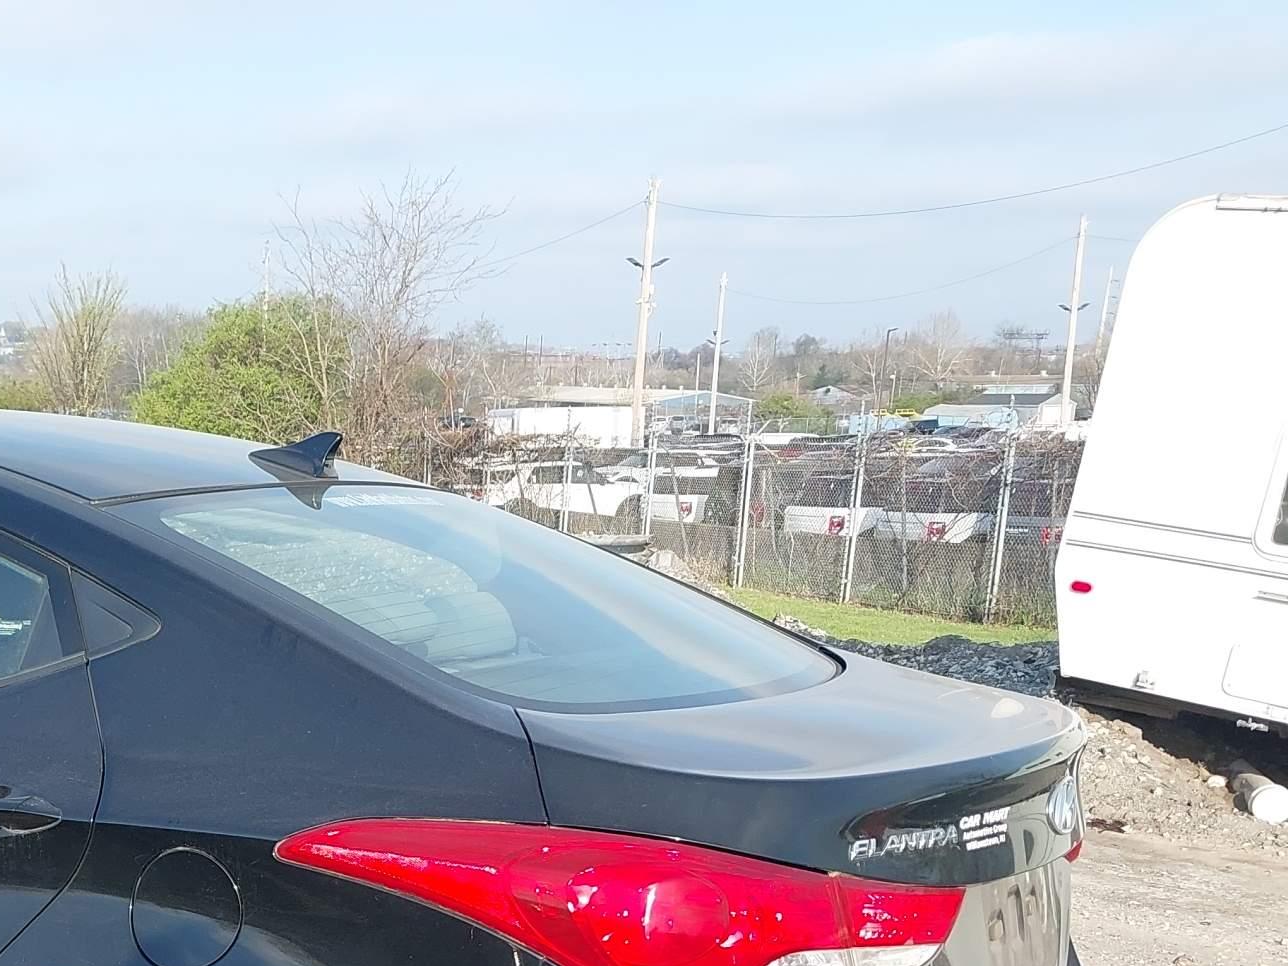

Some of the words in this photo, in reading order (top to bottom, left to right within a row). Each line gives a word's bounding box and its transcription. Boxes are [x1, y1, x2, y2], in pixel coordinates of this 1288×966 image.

[959, 813, 981, 830] CAR
[982, 806, 1011, 825] MART
[849, 823, 959, 861] ELANTRA
